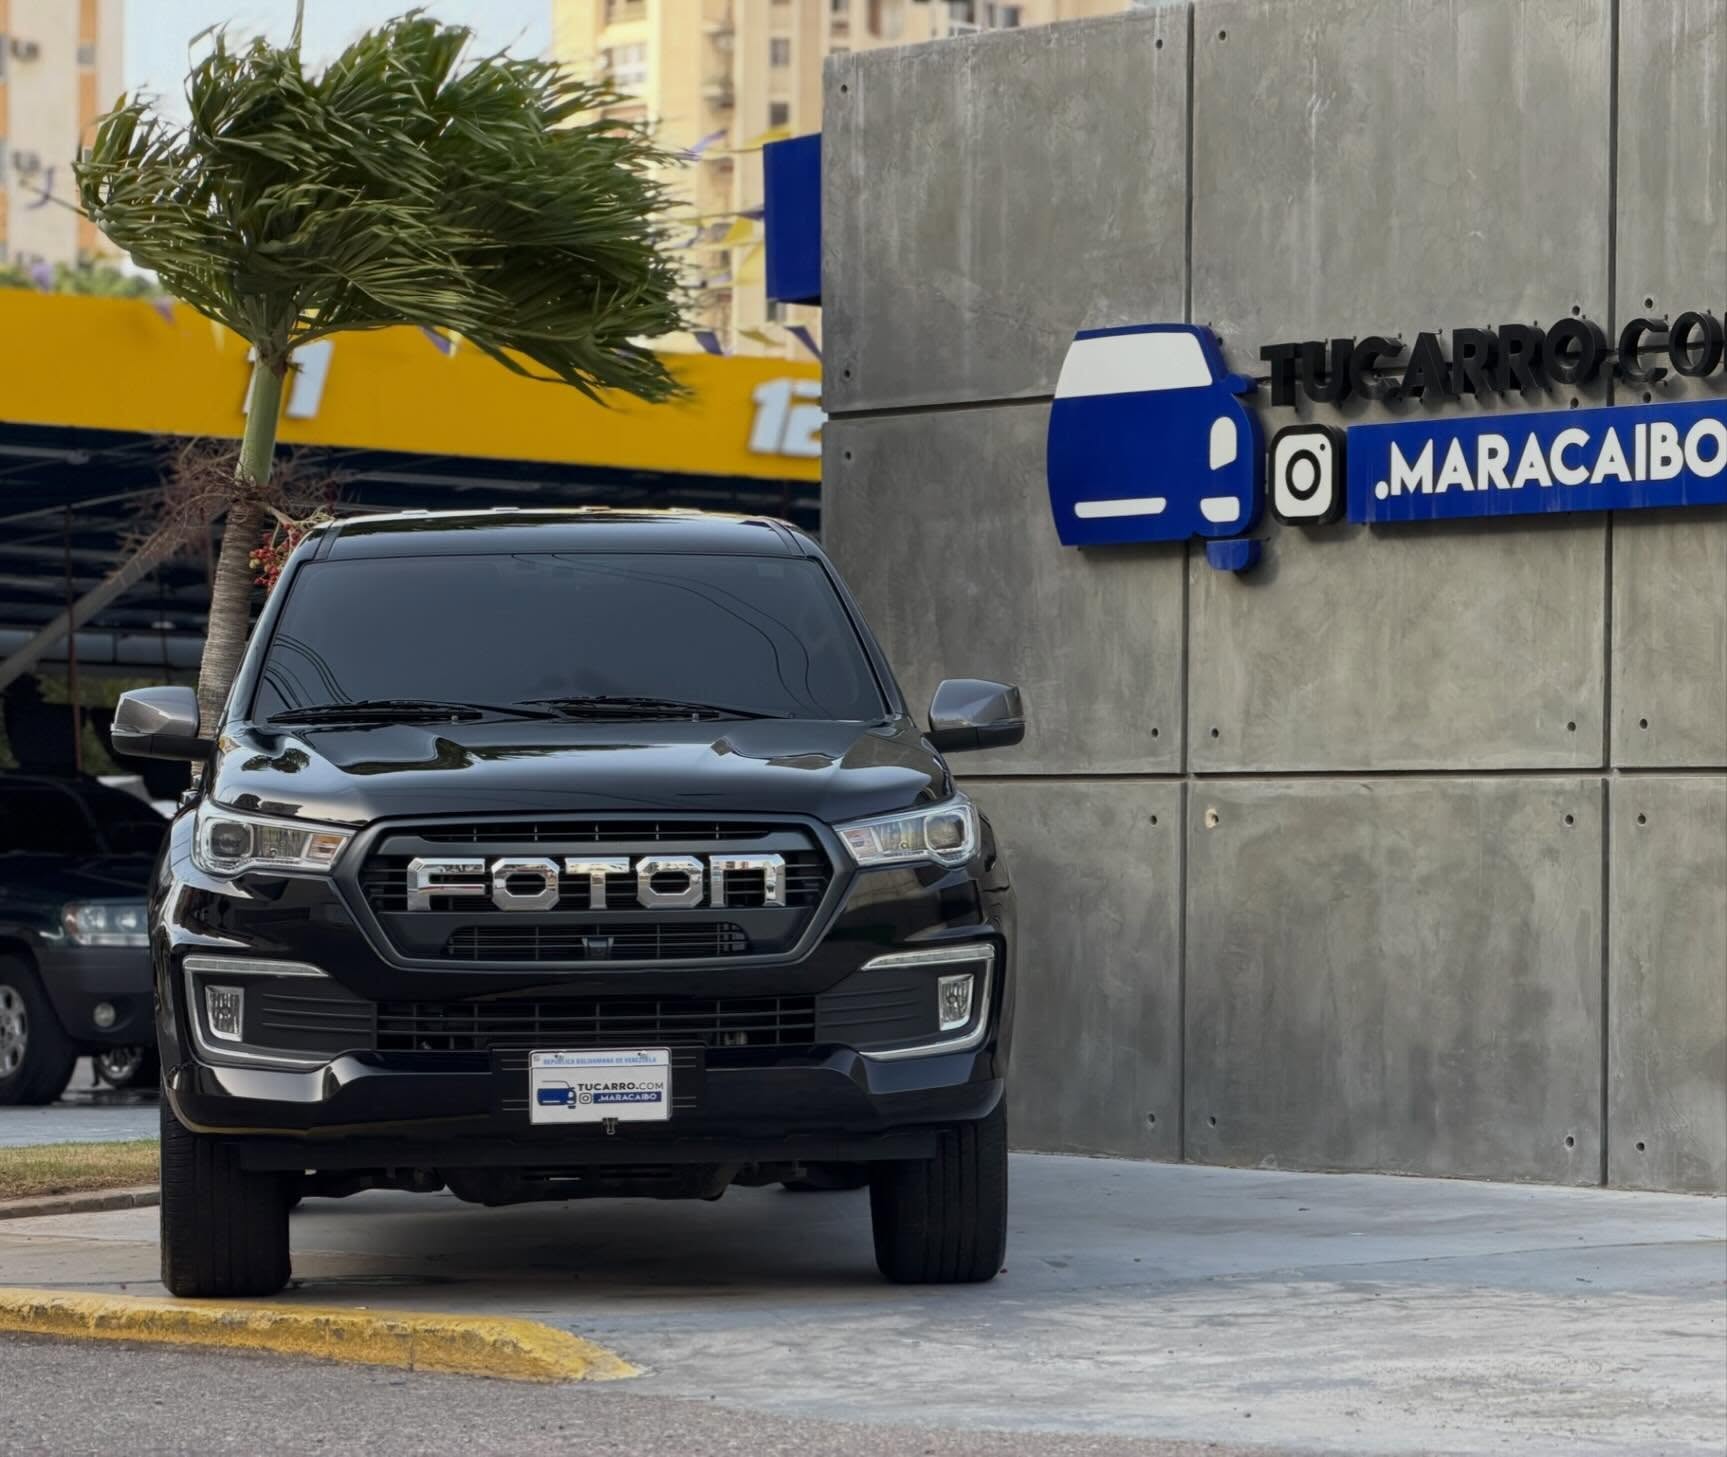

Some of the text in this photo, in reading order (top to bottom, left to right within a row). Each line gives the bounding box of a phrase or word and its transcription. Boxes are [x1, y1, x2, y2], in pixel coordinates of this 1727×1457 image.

[1260, 310, 1727, 407] TUCARRO.CO
[1375, 418, 1727, 500] .MARACAIBO
[407, 853, 786, 911] FOTON
[577, 1082, 663, 1091] TUCARRO.COM
